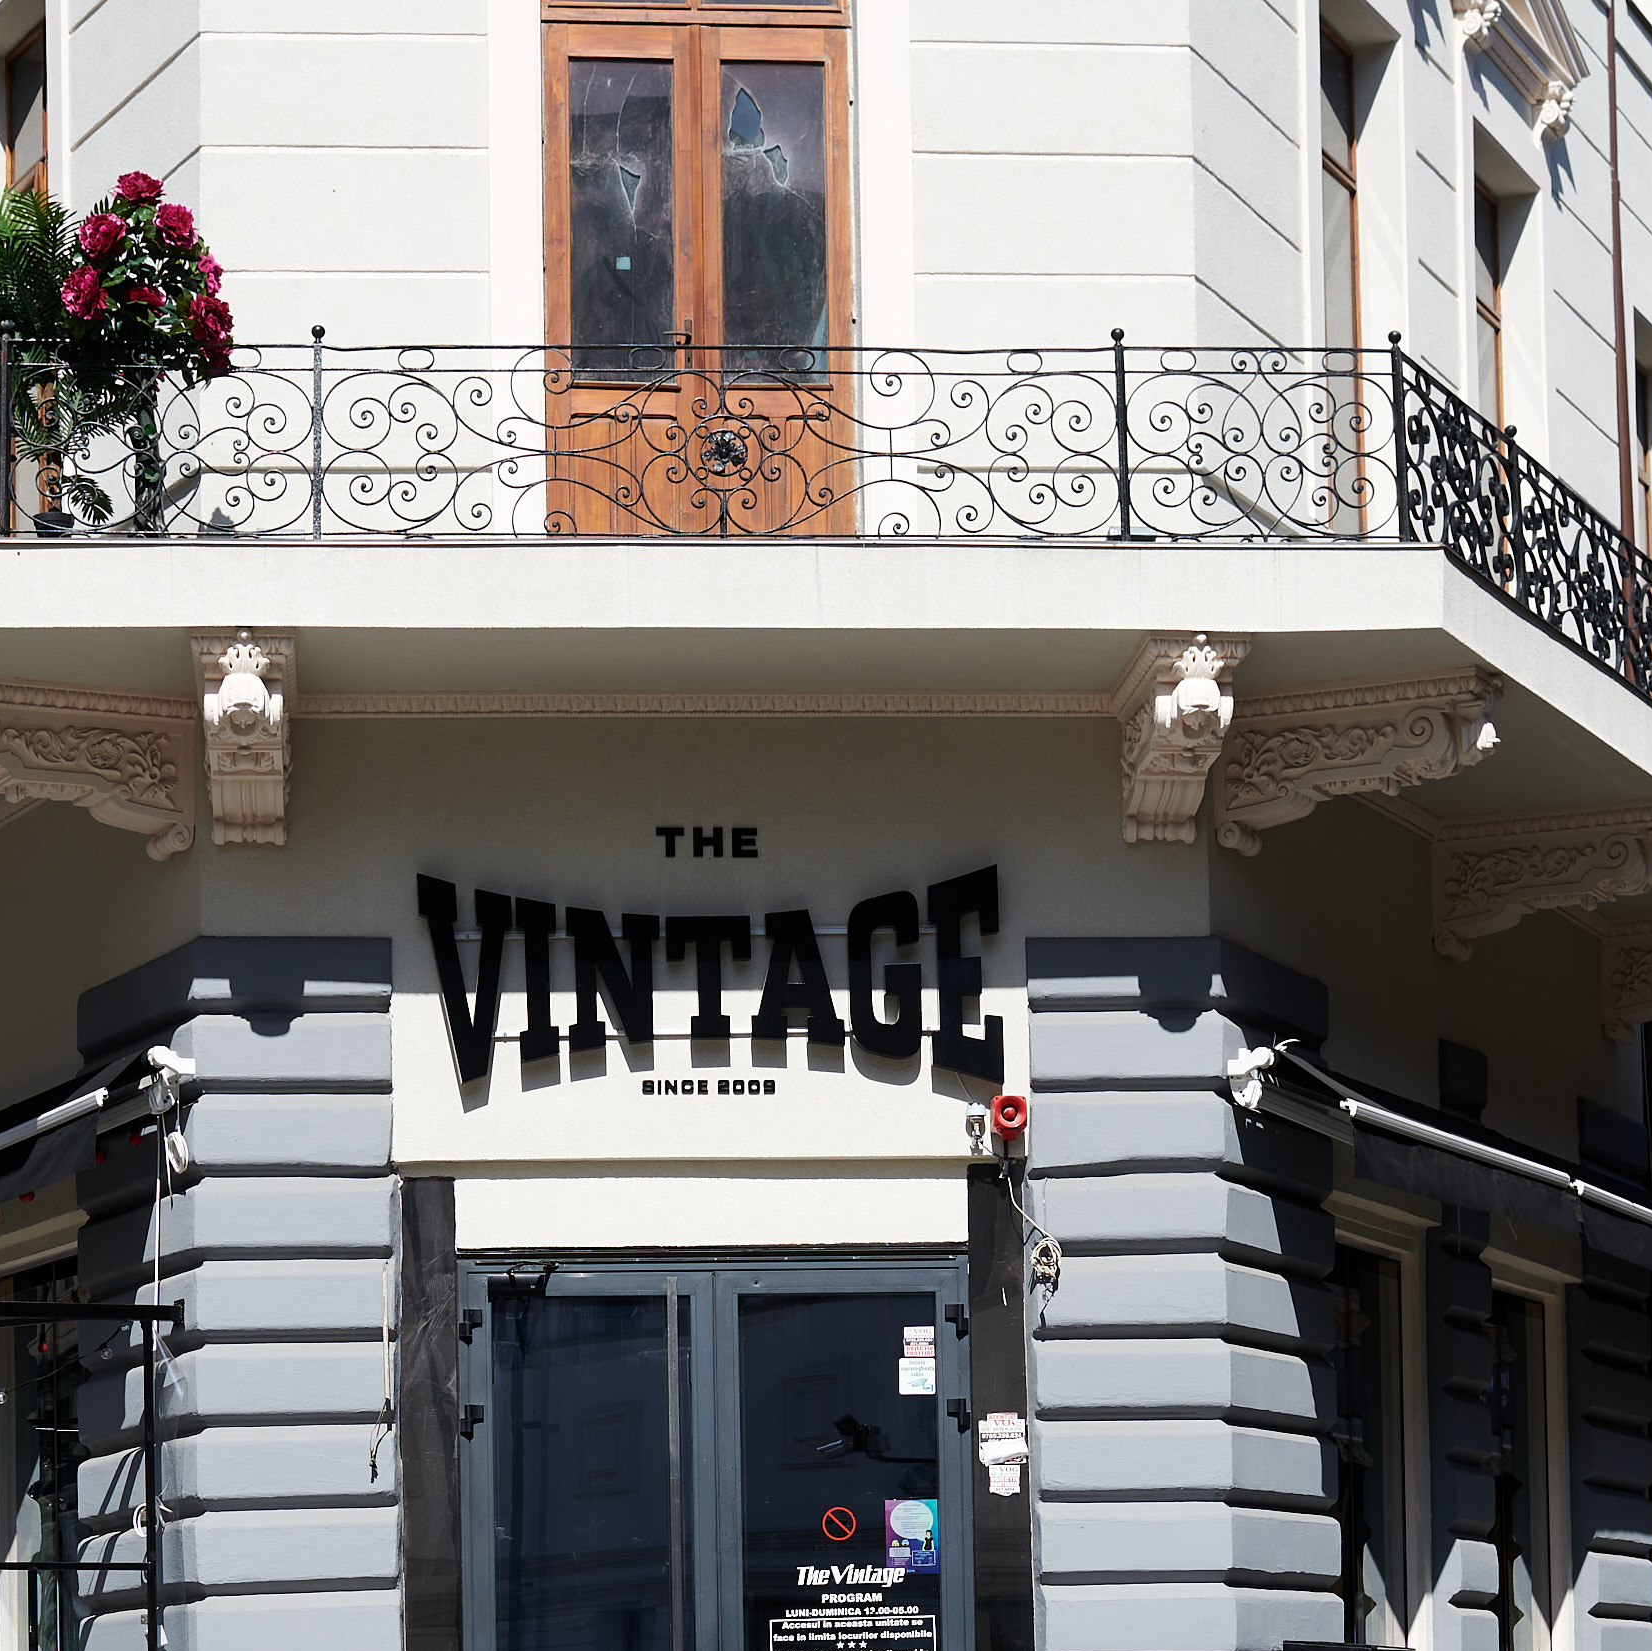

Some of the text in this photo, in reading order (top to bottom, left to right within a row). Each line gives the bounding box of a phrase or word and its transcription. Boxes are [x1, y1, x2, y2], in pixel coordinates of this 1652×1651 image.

[655, 825, 759, 858] THE
[416, 864, 1004, 1085] VINTAGE
[641, 1079, 777, 1096] SINCE 2009
[796, 1563, 906, 1588] The Vintage
[821, 1592, 883, 1604] PROGRAM
[782, 1620, 821, 1630] Accesul
[822, 1620, 833, 1629] in
[834, 1619, 873, 1628] aceasta
[875, 1618, 910, 1627] unitate
[773, 1630, 933, 1642] face in limita locurilor disponibile
